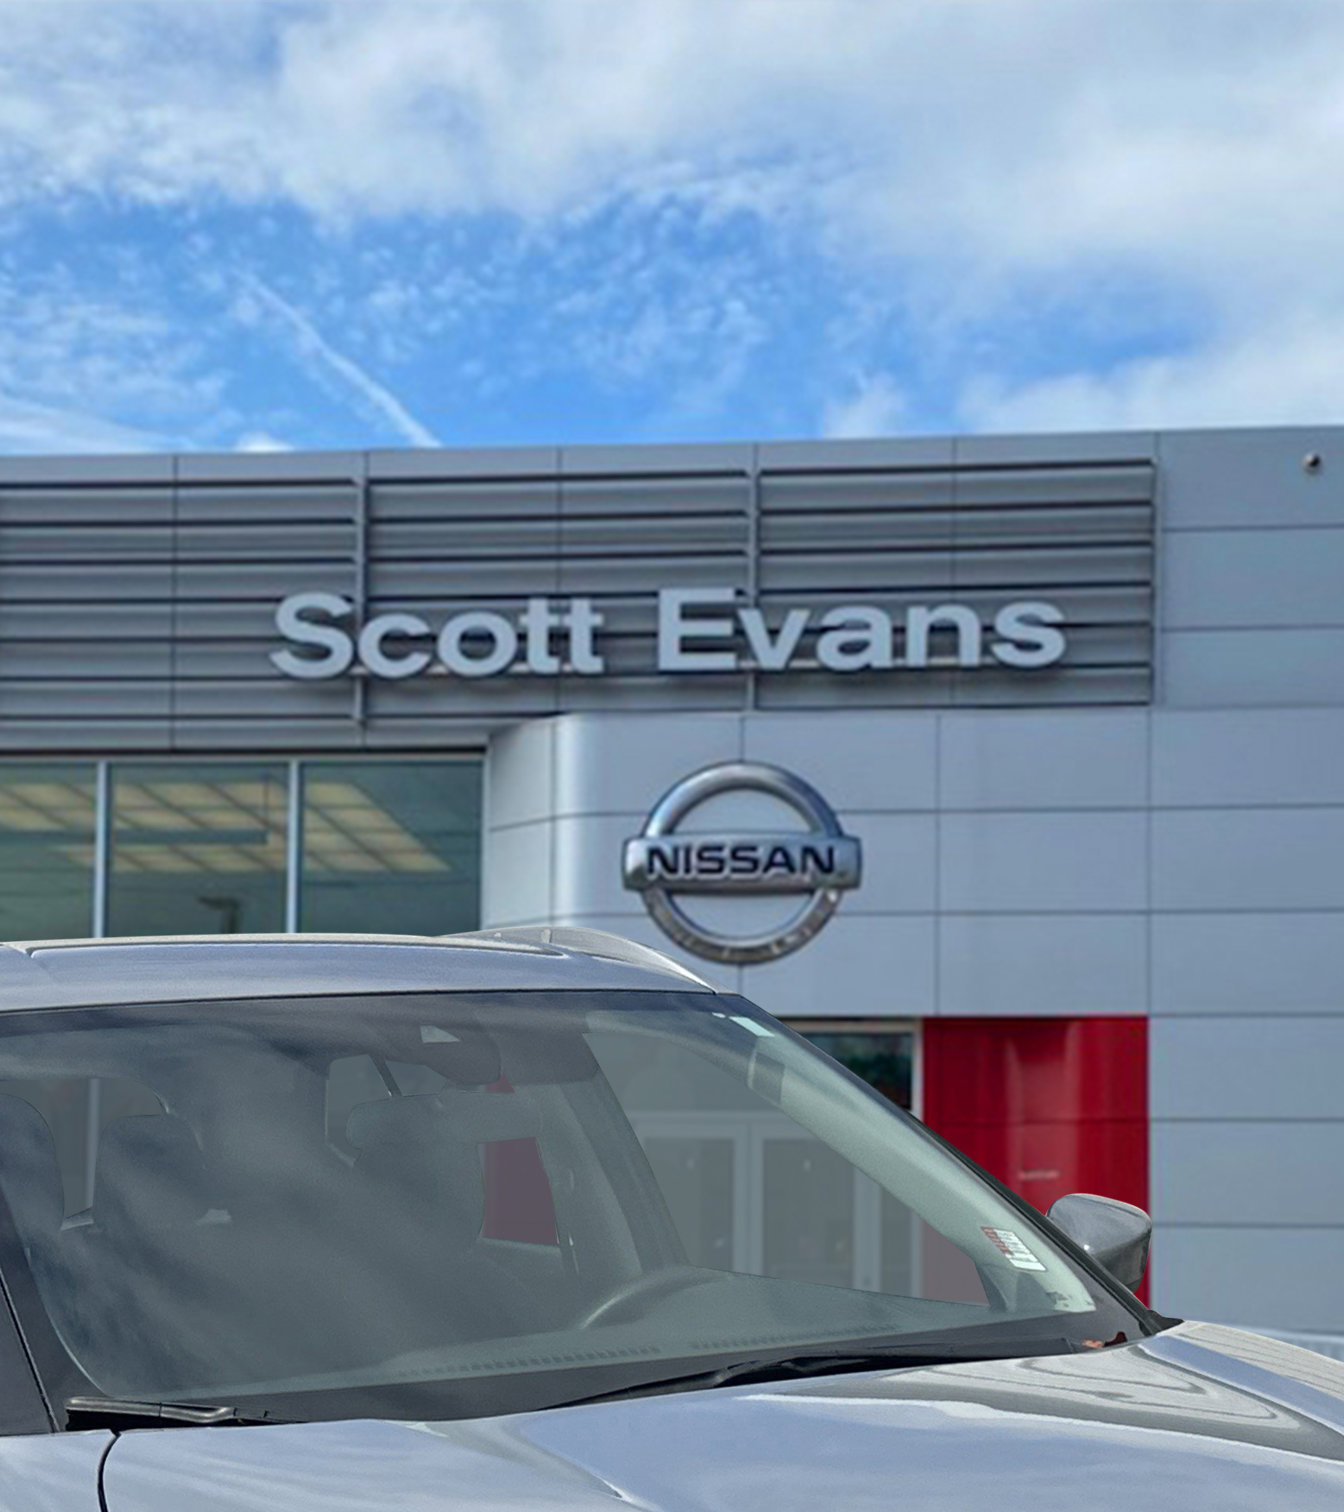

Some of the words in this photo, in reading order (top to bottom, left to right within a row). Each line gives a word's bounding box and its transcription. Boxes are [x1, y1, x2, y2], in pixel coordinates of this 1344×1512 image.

[269, 591, 605, 679] Scott
[658, 587, 1067, 672] Evans
[646, 845, 835, 875] NISSAN
